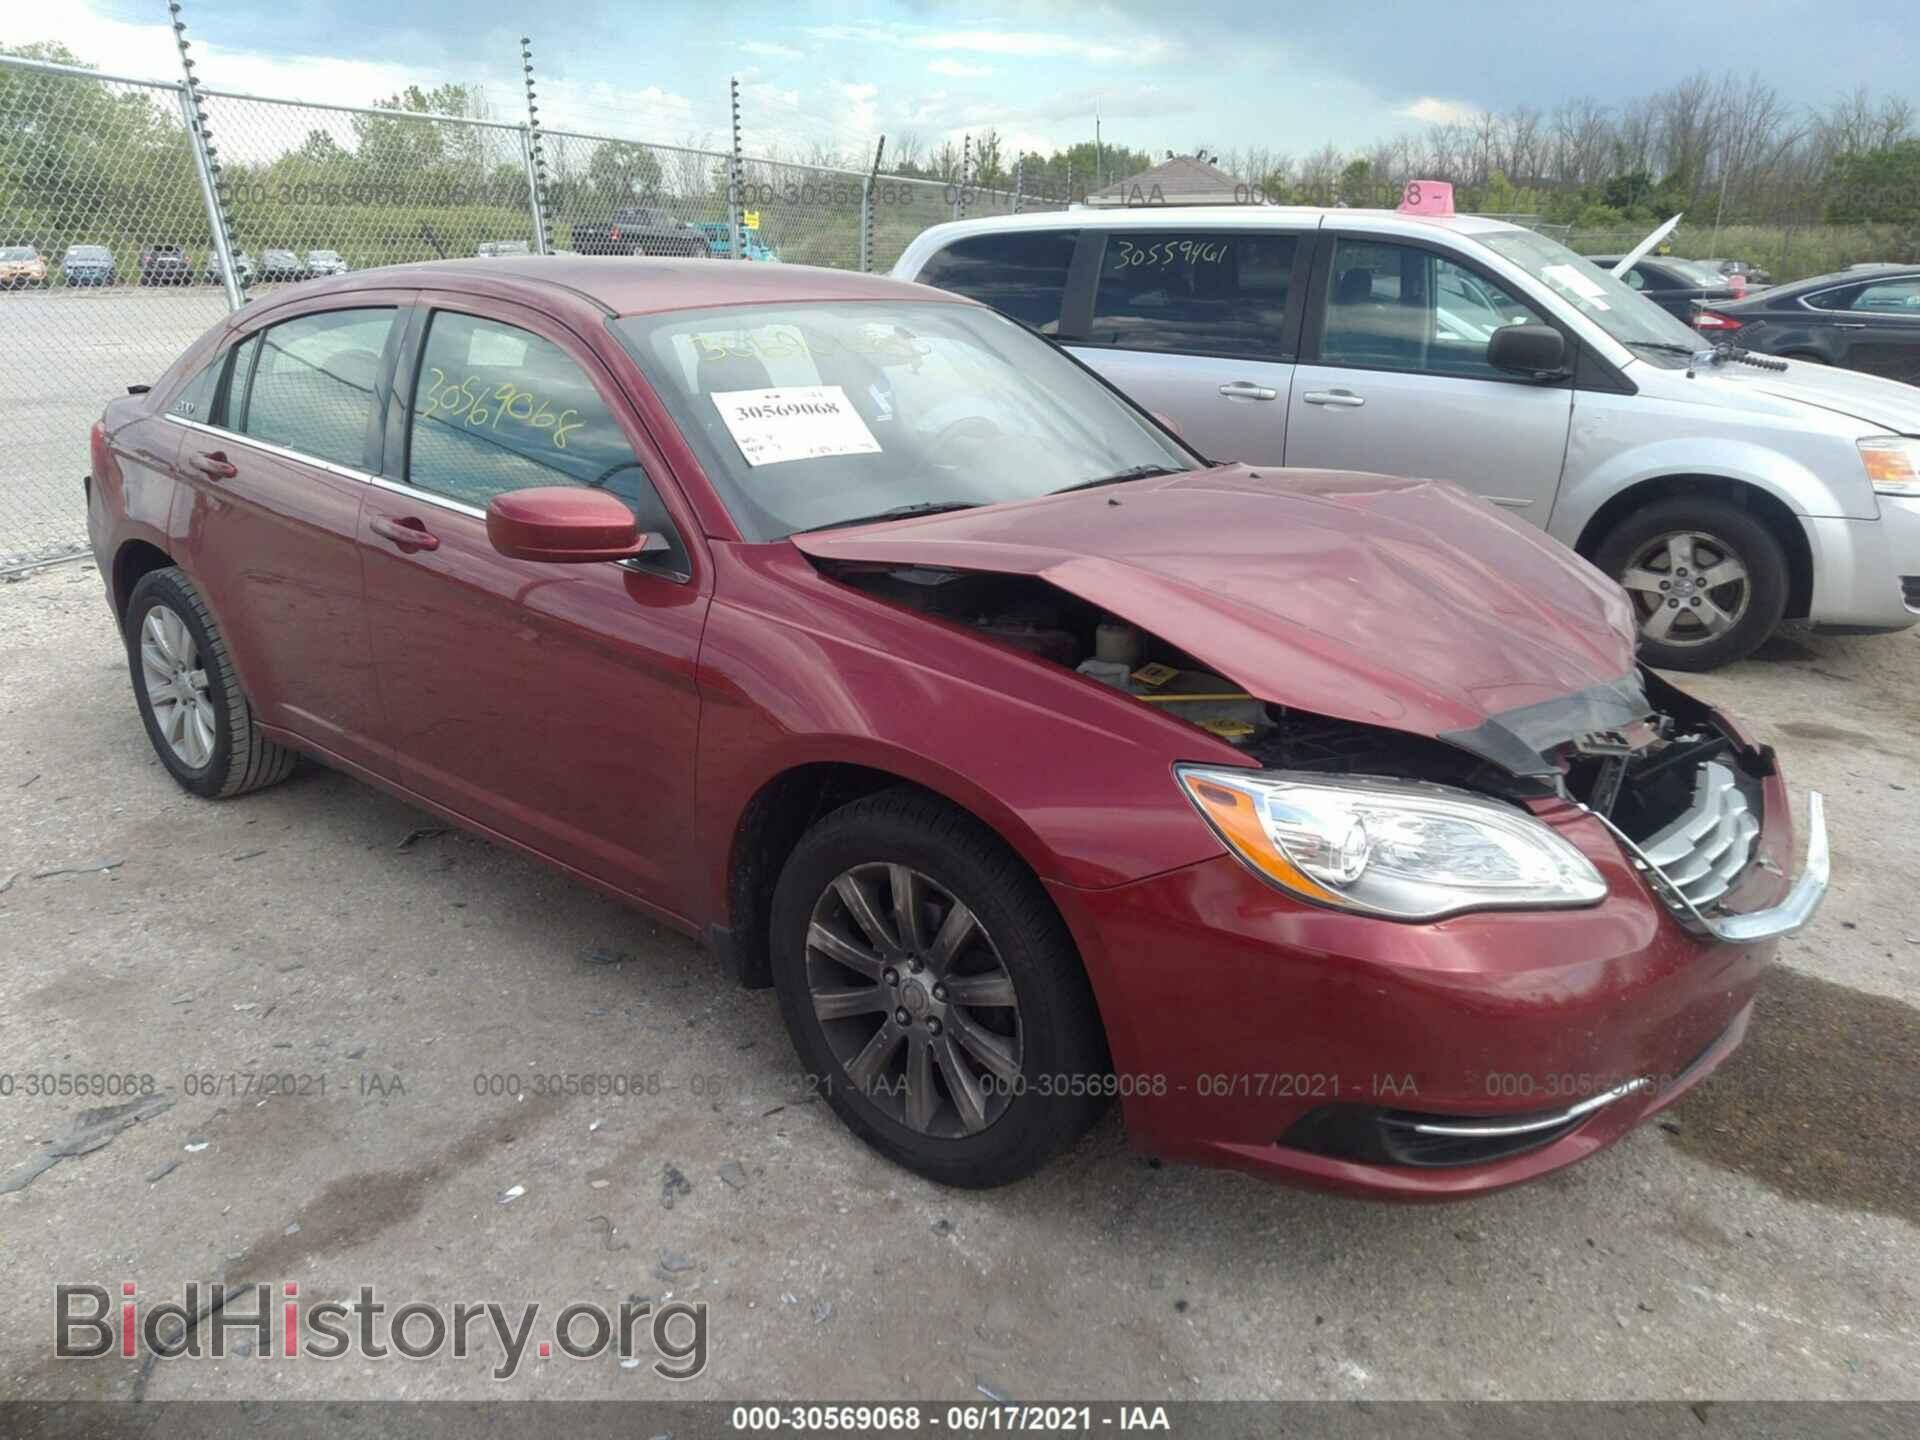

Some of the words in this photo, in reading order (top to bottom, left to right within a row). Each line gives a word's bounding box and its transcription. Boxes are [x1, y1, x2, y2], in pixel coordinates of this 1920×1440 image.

[1113, 241, 1227, 269] 30559461
[424, 367, 586, 449] 30569068
[735, 402, 840, 421] 30569068
